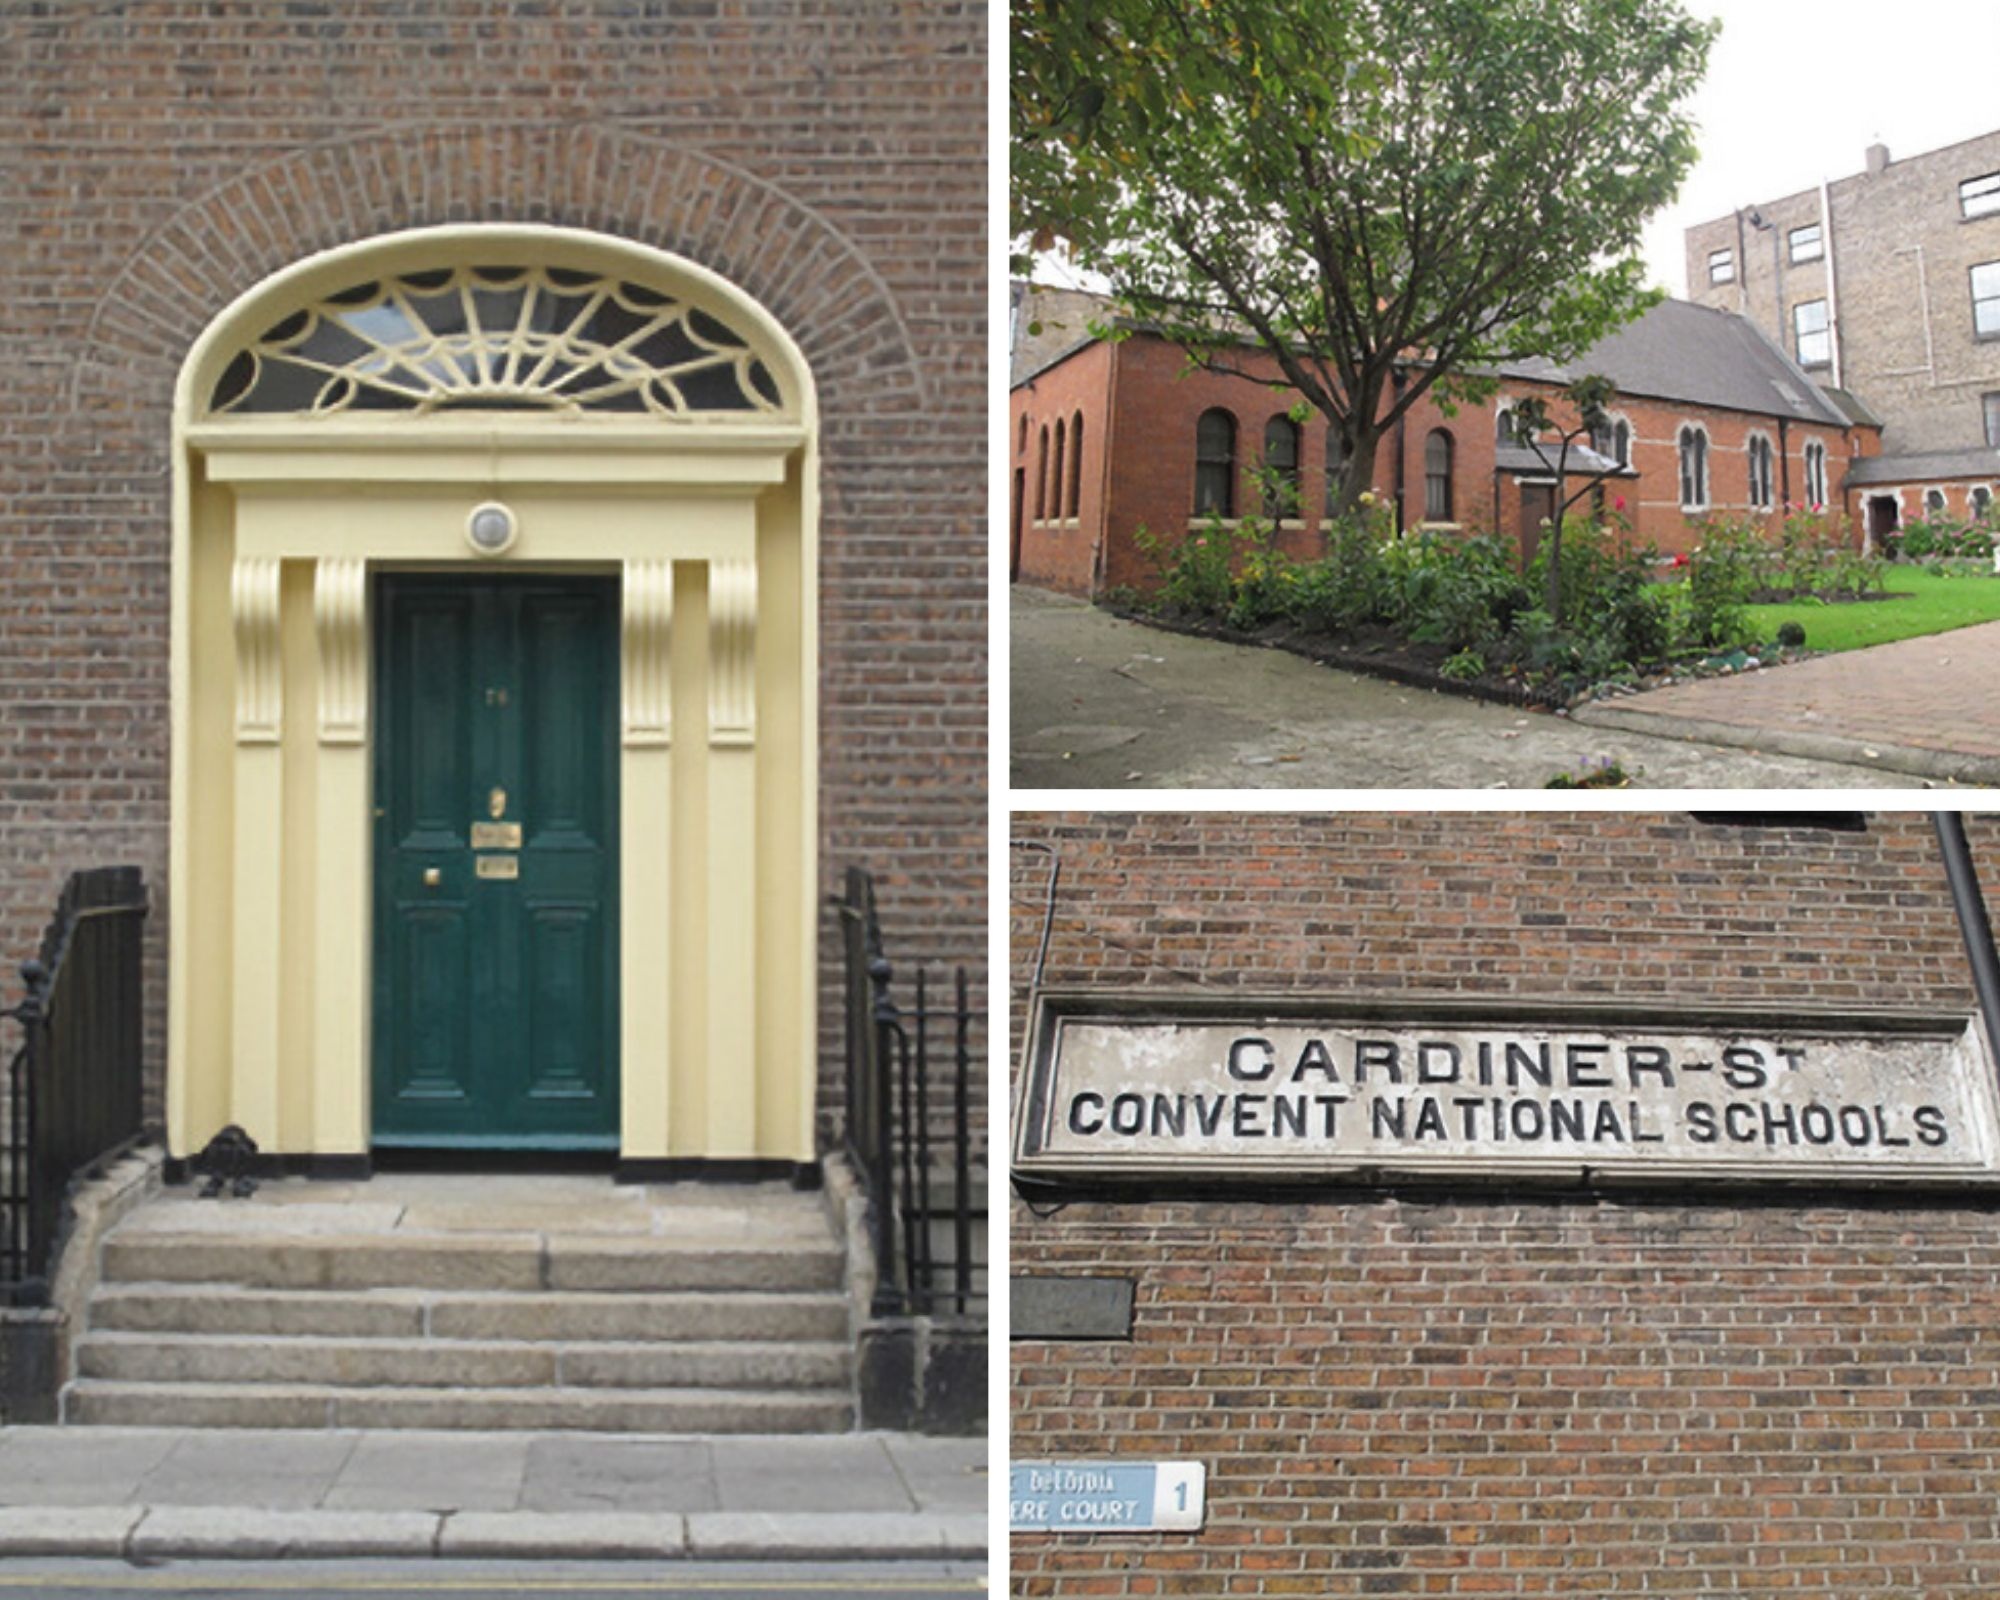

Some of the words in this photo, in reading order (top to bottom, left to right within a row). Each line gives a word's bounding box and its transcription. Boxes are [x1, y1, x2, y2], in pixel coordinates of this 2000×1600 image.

[1068, 1091, 1350, 1139] CONVENT
[1371, 1096, 1664, 1143] NATIONAL
[1685, 1100, 1949, 1148] SCHOOLS
[1060, 1500, 1139, 1521] COURT
[1174, 1481, 1188, 1512] 1
